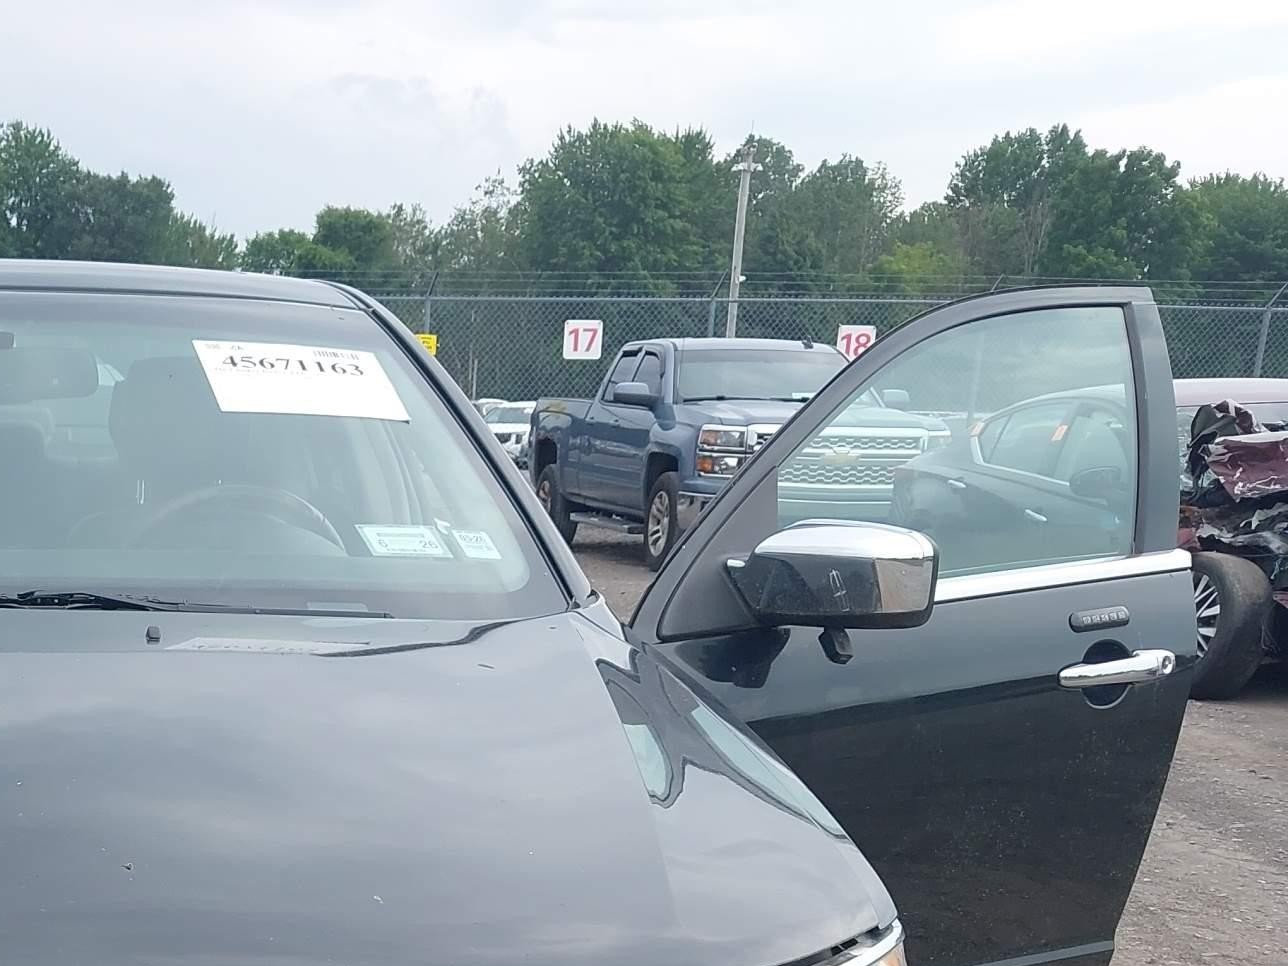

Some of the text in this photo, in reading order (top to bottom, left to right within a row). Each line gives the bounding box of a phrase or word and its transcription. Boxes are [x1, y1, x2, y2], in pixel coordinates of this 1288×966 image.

[568, 328, 598, 352] 17
[840, 333, 871, 357] 18
[222, 355, 364, 376] 45671163
